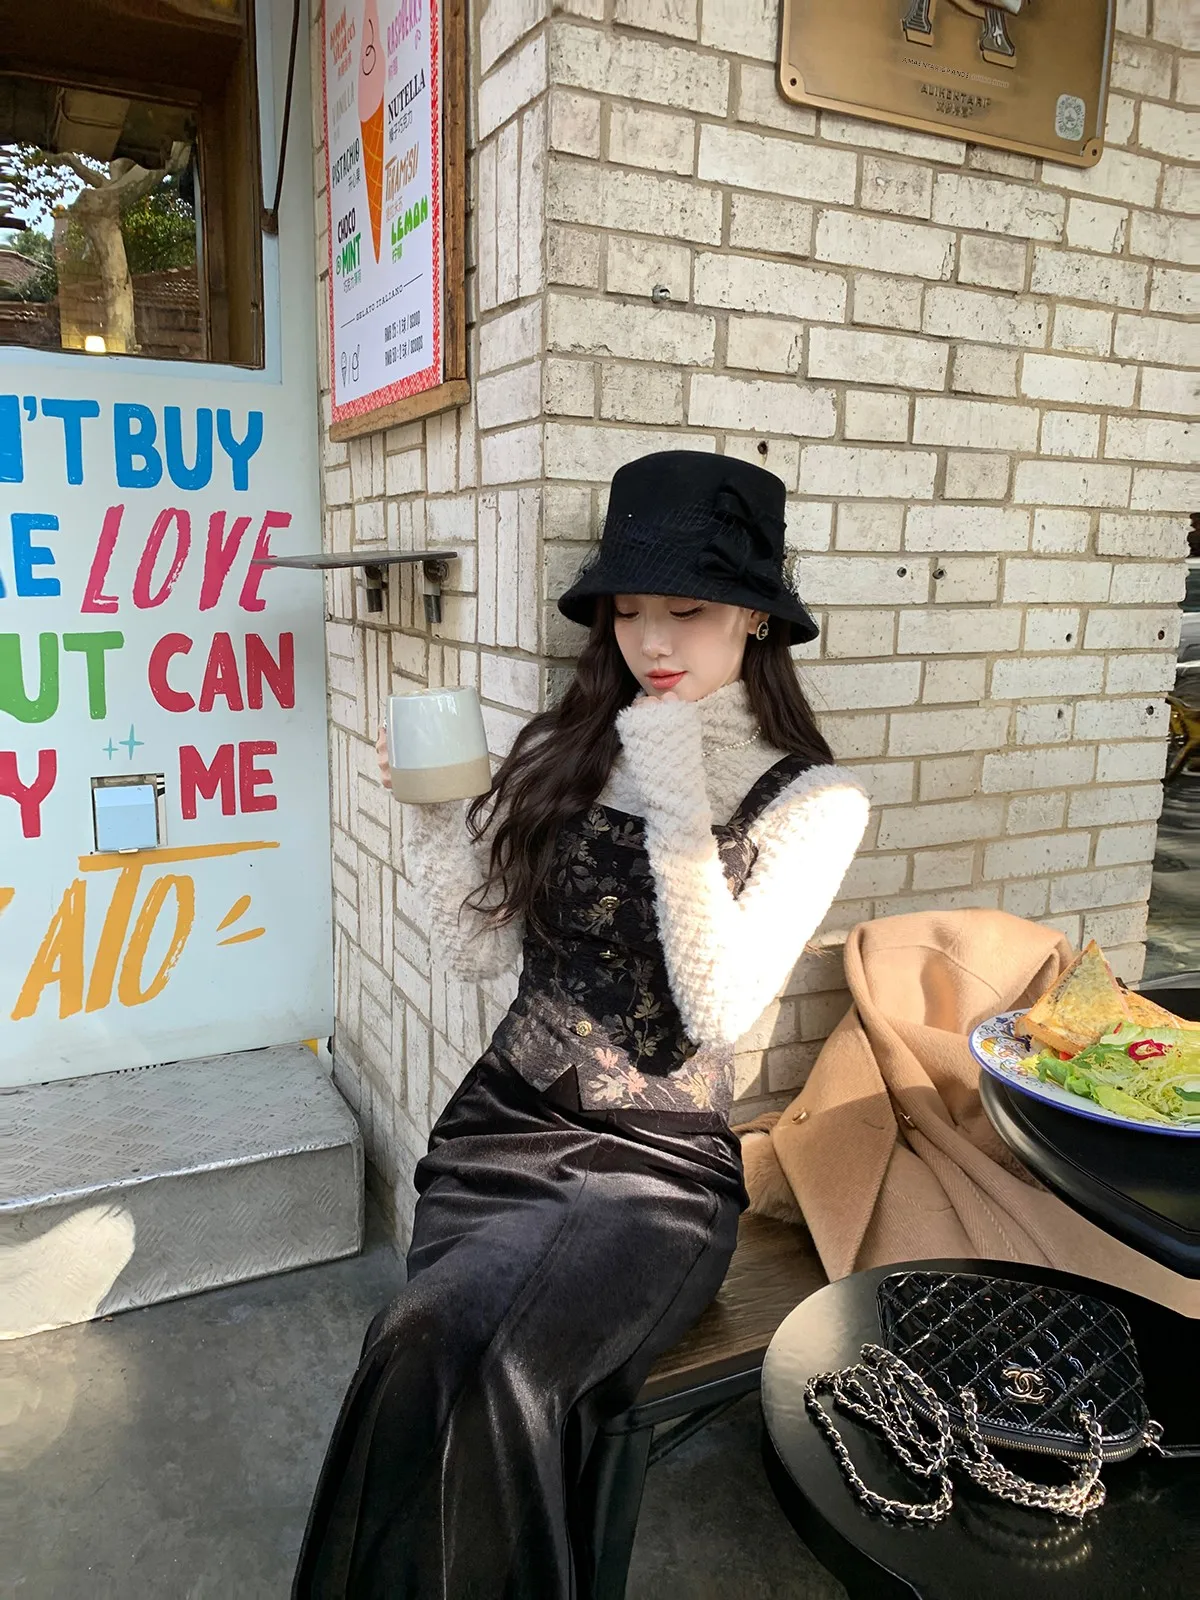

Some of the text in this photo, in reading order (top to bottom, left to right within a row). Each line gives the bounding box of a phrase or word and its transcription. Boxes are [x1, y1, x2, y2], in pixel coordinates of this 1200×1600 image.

[388, 68, 426, 125] NUTELLA
[332, 137, 360, 189] PISTACHIO
[337, 207, 356, 244] CHOCO
[391, 195, 428, 246] LEMON
[342, 232, 362, 278] MINT
[113, 402, 263, 491] BUY
[80, 504, 292, 614] LOVE
[148, 631, 295, 713] CAN
[179, 741, 278, 820] ME
